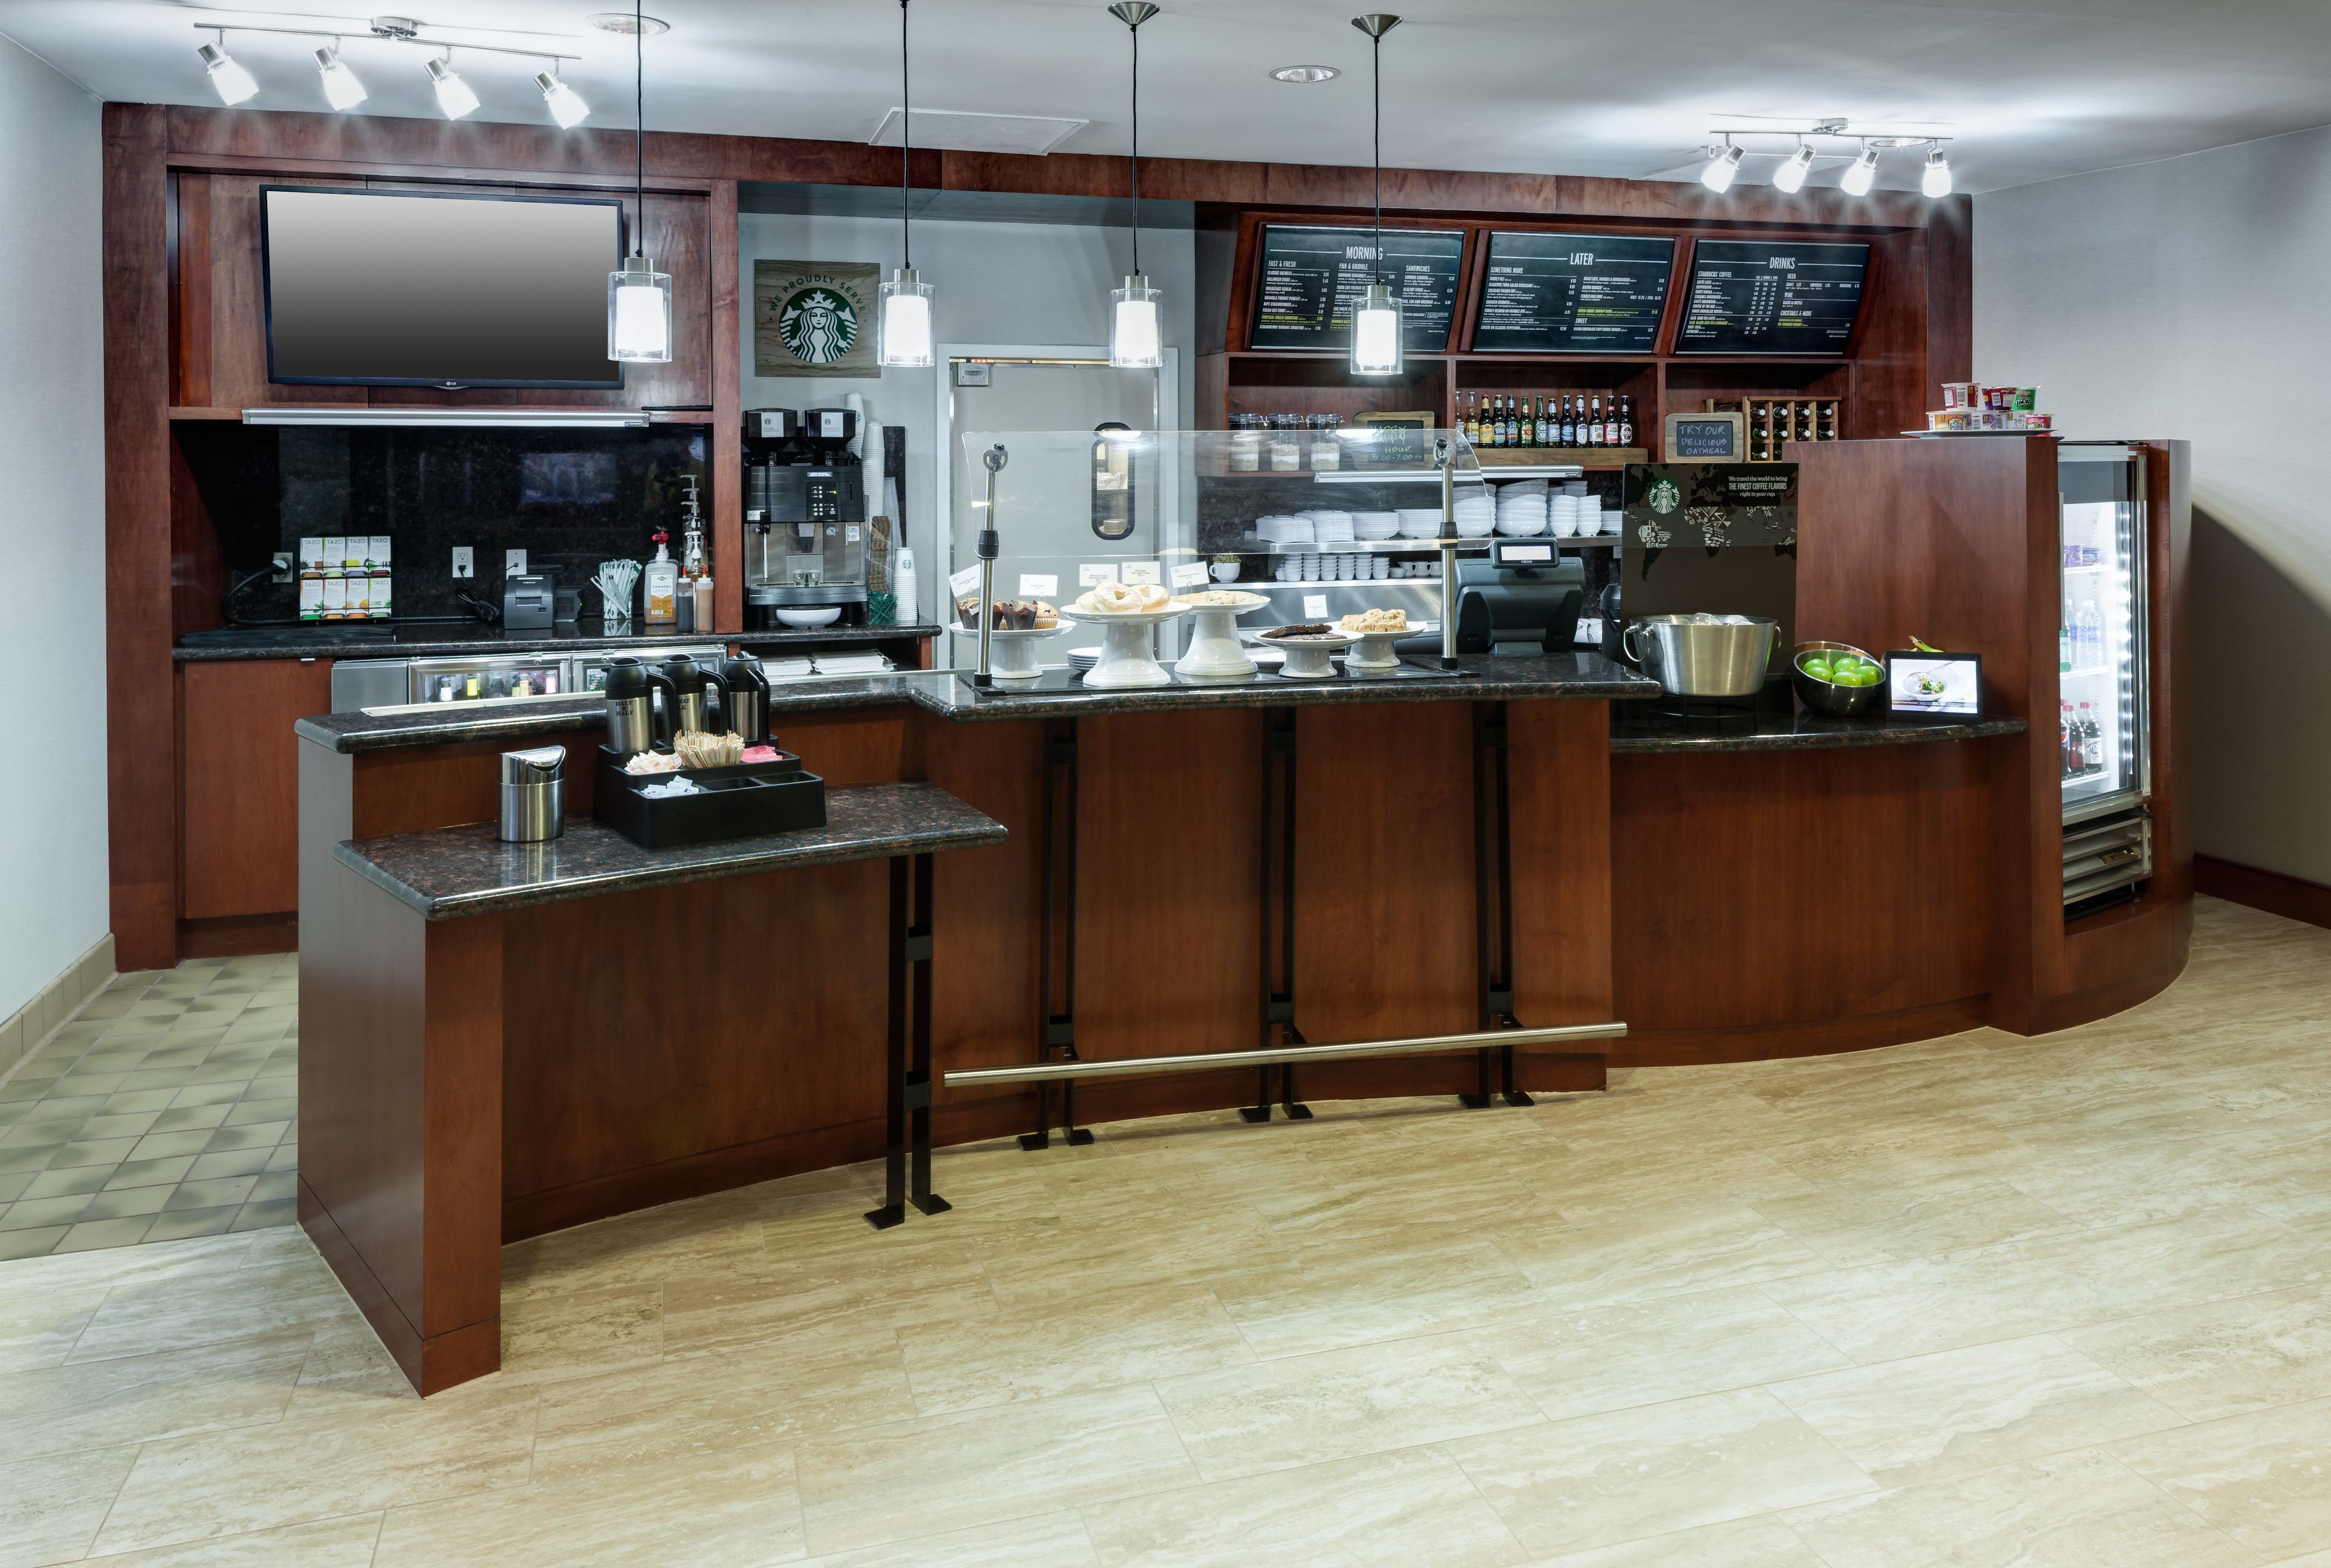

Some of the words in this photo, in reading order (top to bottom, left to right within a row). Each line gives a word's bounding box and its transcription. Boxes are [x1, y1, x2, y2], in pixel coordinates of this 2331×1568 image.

[1346, 246, 1383, 260] MORNING
[1570, 253, 1593, 265] LATER
[1769, 257, 1796, 270] DRINKS
[782, 275, 836, 293] PROUDLY
[769, 294, 782, 311] WE
[839, 281, 866, 313] SERVE
[2016, 399, 2031, 409] JACKS
[1369, 425, 1407, 445] APPY
[1679, 424, 1703, 435] TRY
[1705, 425, 1726, 435] OUR
[1681, 438, 1728, 446] DELICIOUS
